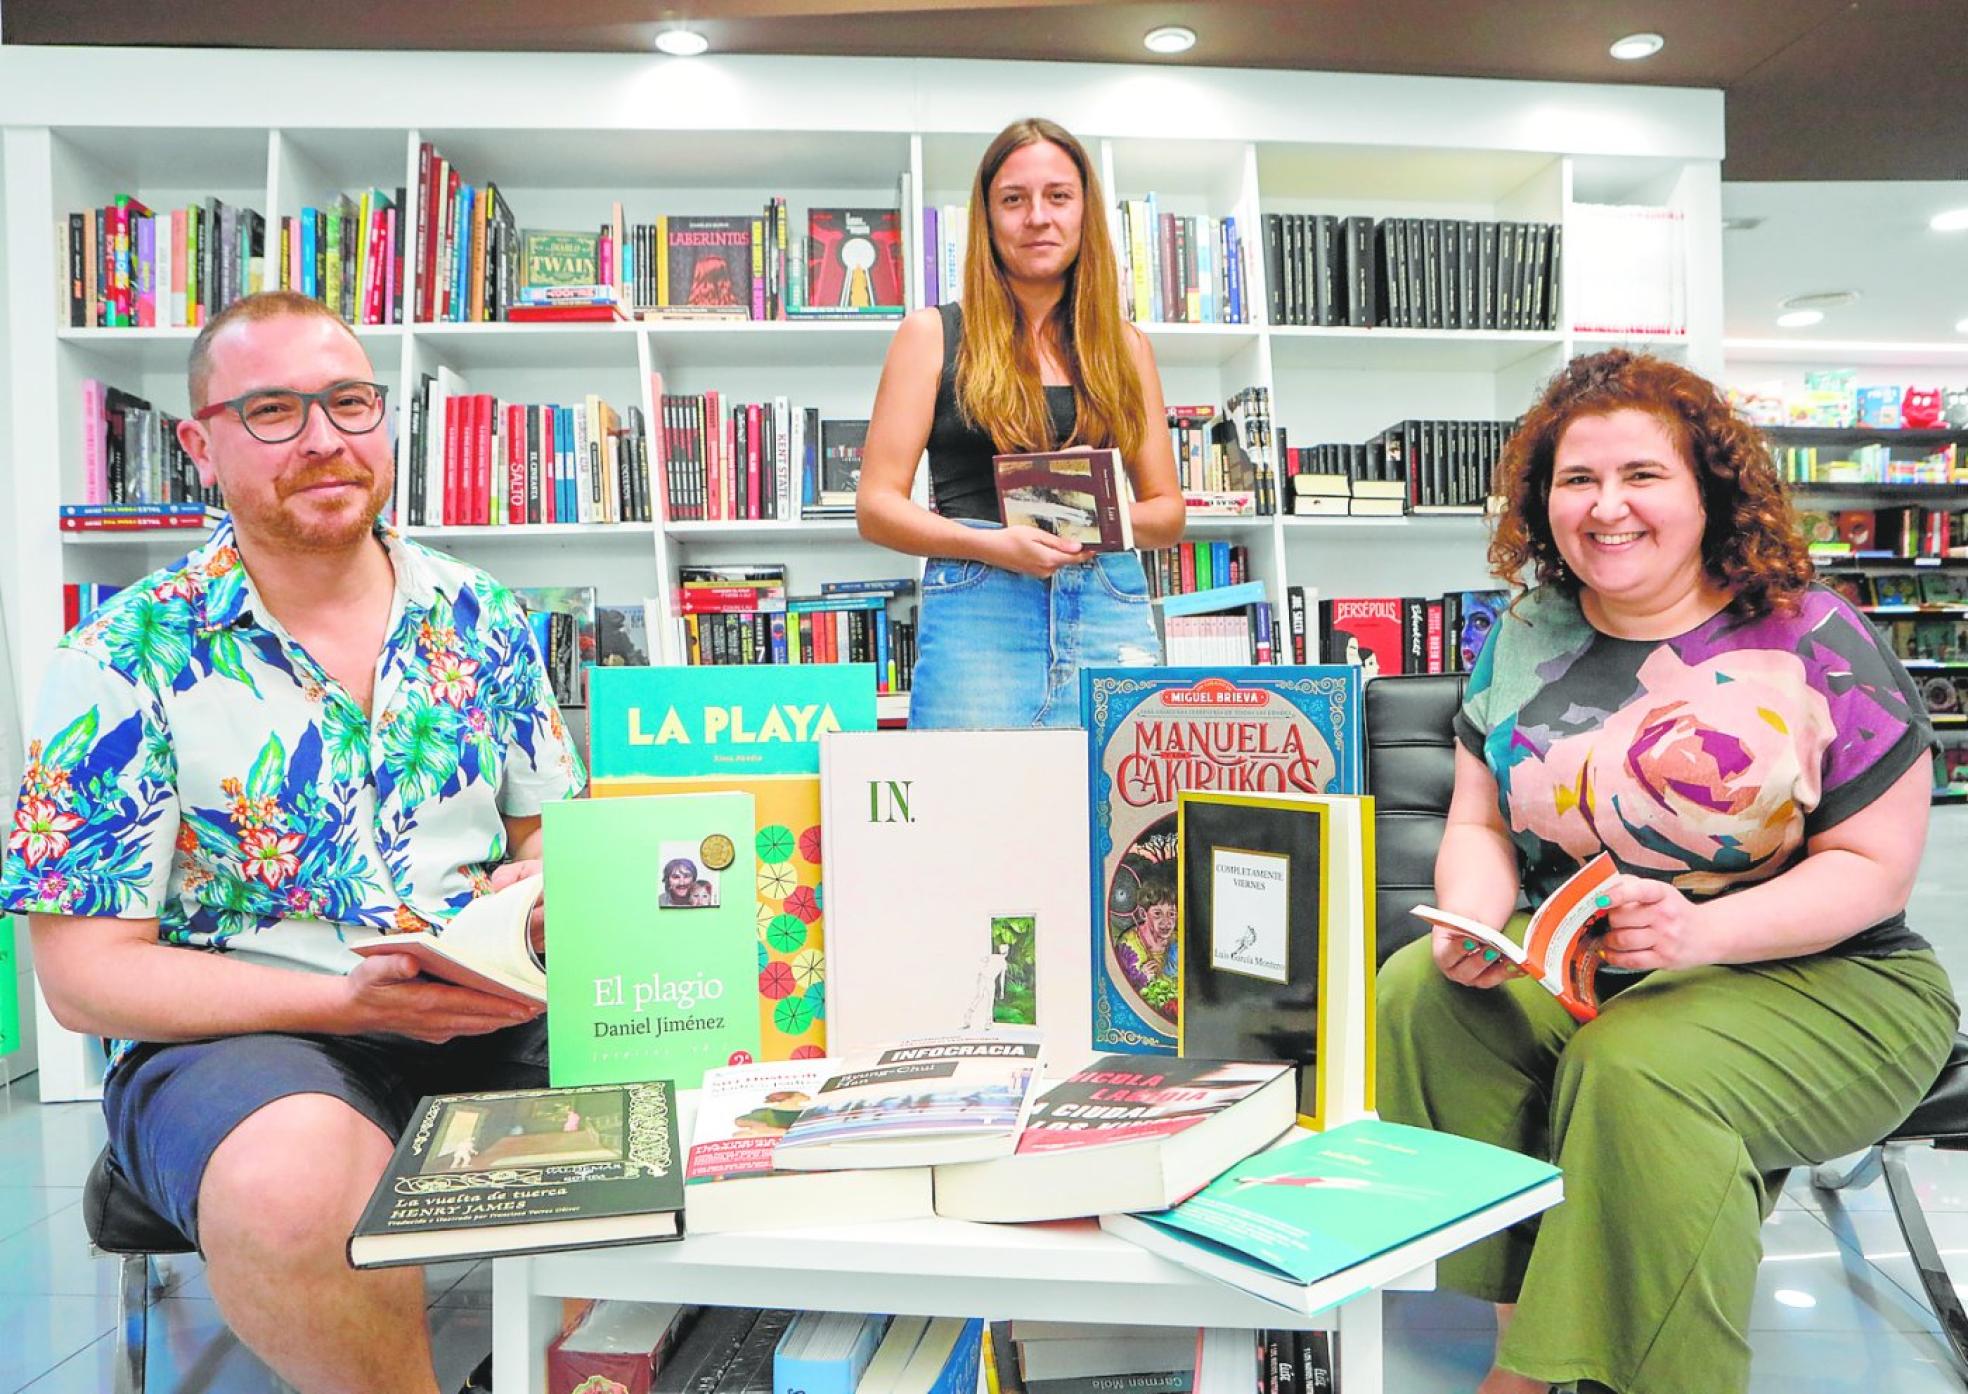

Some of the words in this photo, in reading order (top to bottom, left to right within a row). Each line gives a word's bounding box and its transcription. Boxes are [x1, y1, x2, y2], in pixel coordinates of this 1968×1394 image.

[669, 231, 750, 246] LABERINTOS
[531, 256, 595, 273] TWAIN
[777, 433, 788, 464] KENT
[511, 463, 524, 506] SALTO
[778, 466, 789, 501] STATE
[1336, 601, 1400, 622] PERSÉPOLIS
[1171, 692, 1213, 703] MIGUEL
[1216, 692, 1258, 703] BRIEVA
[627, 704, 691, 746] LA
[704, 703, 842, 743] PLAYA
[1134, 720, 1316, 777] MANUELA
[867, 780, 916, 823] IN.
[1216, 863, 1284, 882] COMPLETAMENTE
[1233, 878, 1266, 891] VIERNES
[1215, 947, 1229, 959] Luis
[1231, 951, 1254, 965] García
[593, 974, 624, 1007] El
[634, 971, 724, 1012] plagio
[594, 1017, 651, 1038] Daniel
[656, 1014, 725, 1038] Jiménez
[891, 1043, 1027, 1061] INFOCRACIA
[839, 1063, 936, 1083] Byung-Chul
[395, 1198, 420, 1208] La
[425, 1193, 481, 1206] vuelta
[487, 1190, 507, 1200] de
[513, 1188, 568, 1199] tuerca
[391, 1205, 461, 1219] HENRY
[462, 1200, 527, 1214] JAMES
[1092, 1378, 1124, 1389] Mola
[1128, 1376, 1183, 1387] Carmen
